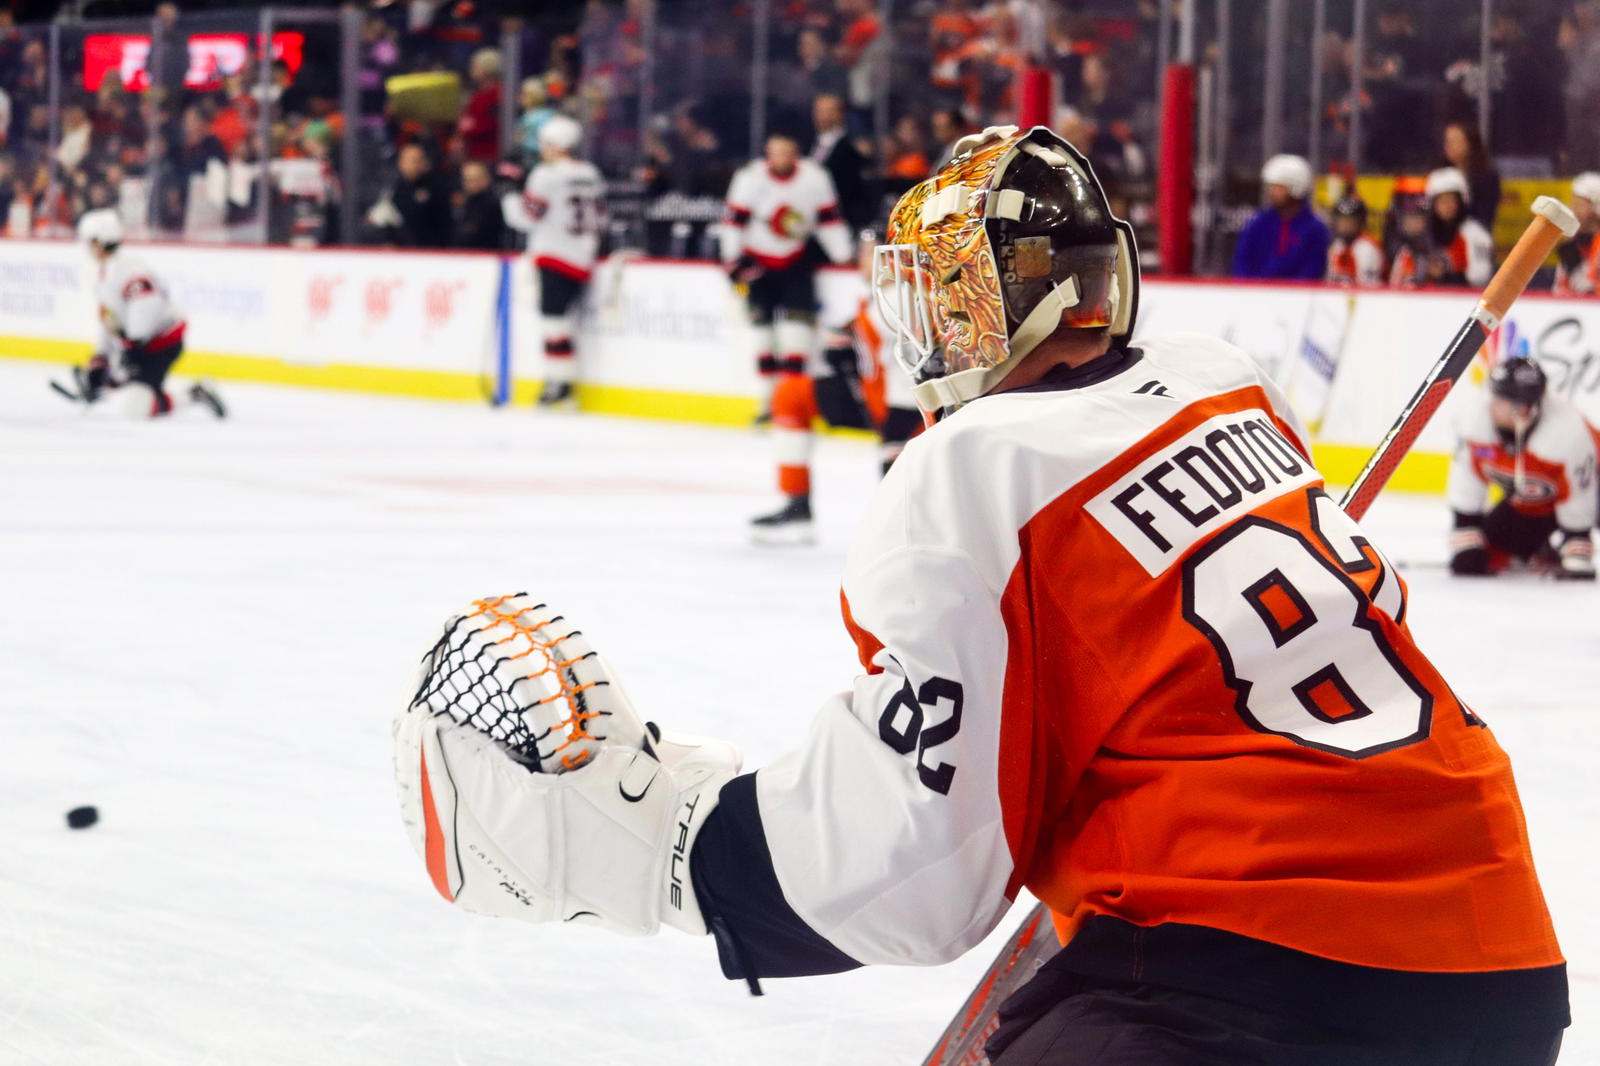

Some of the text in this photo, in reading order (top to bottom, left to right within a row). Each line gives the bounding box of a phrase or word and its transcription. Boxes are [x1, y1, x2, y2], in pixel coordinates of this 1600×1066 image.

[1181, 486, 1487, 759] 82
[878, 653, 964, 796] 82
[670, 793, 700, 911] TRUE
